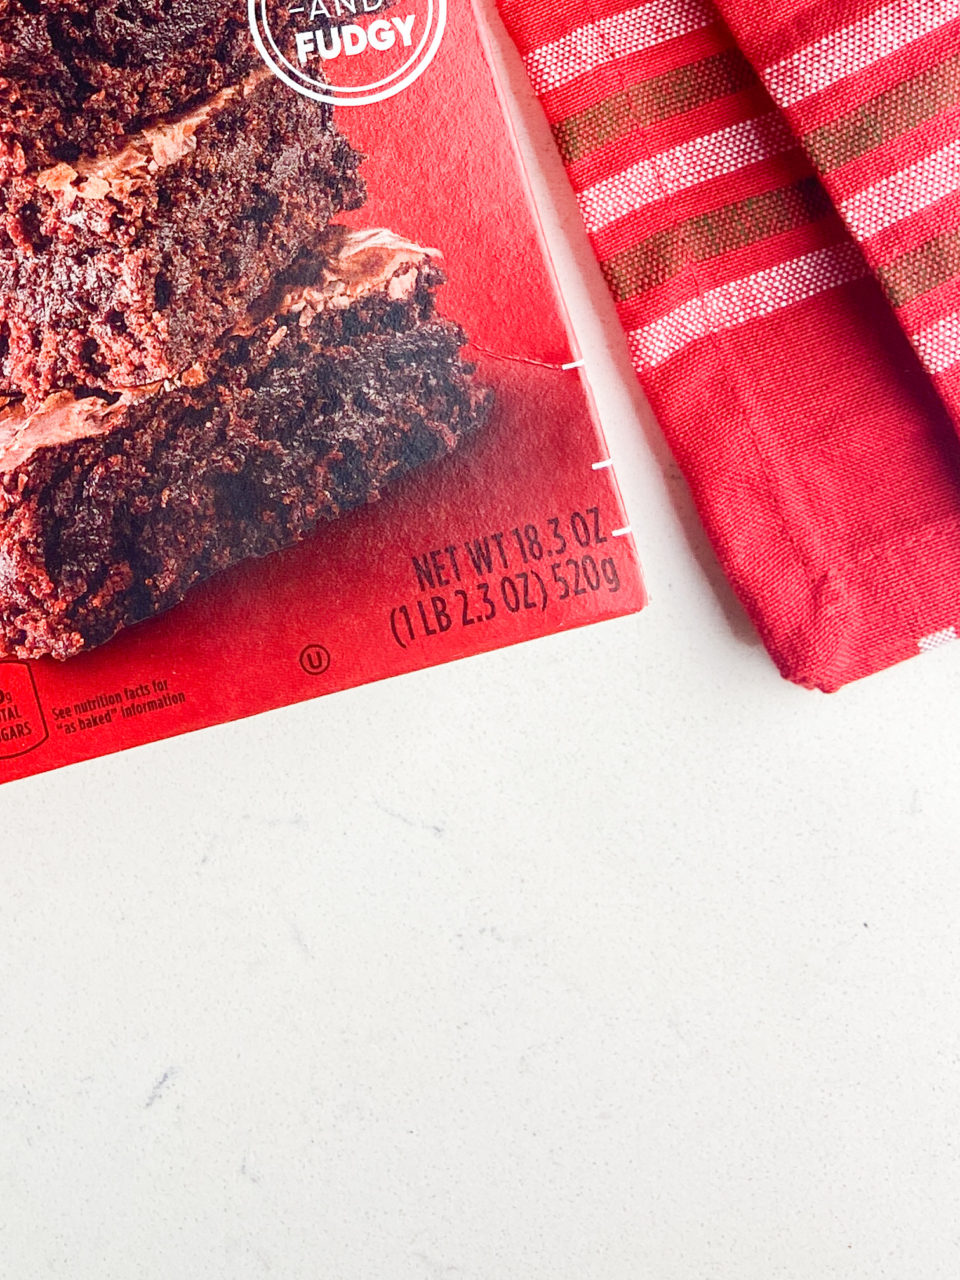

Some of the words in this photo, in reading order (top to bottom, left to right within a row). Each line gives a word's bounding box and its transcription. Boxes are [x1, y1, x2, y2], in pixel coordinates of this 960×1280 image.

[295, 14, 416, 64] FUDGY
[411, 544, 461, 592] NET
[464, 530, 508, 576] WT
[512, 517, 567, 564] 18.3
[570, 506, 608, 546] OZ
[389, 602, 416, 649] (1
[422, 594, 452, 638] LB
[456, 582, 497, 627] 2.3
[500, 567, 547, 613] OZ)
[552, 553, 621, 602] 520g
[52, 706, 72, 721] See
[74, 692, 123, 714] nutrition
[123, 683, 151, 701] facts
[152, 680, 168, 693] for
[121, 692, 186, 719] information
